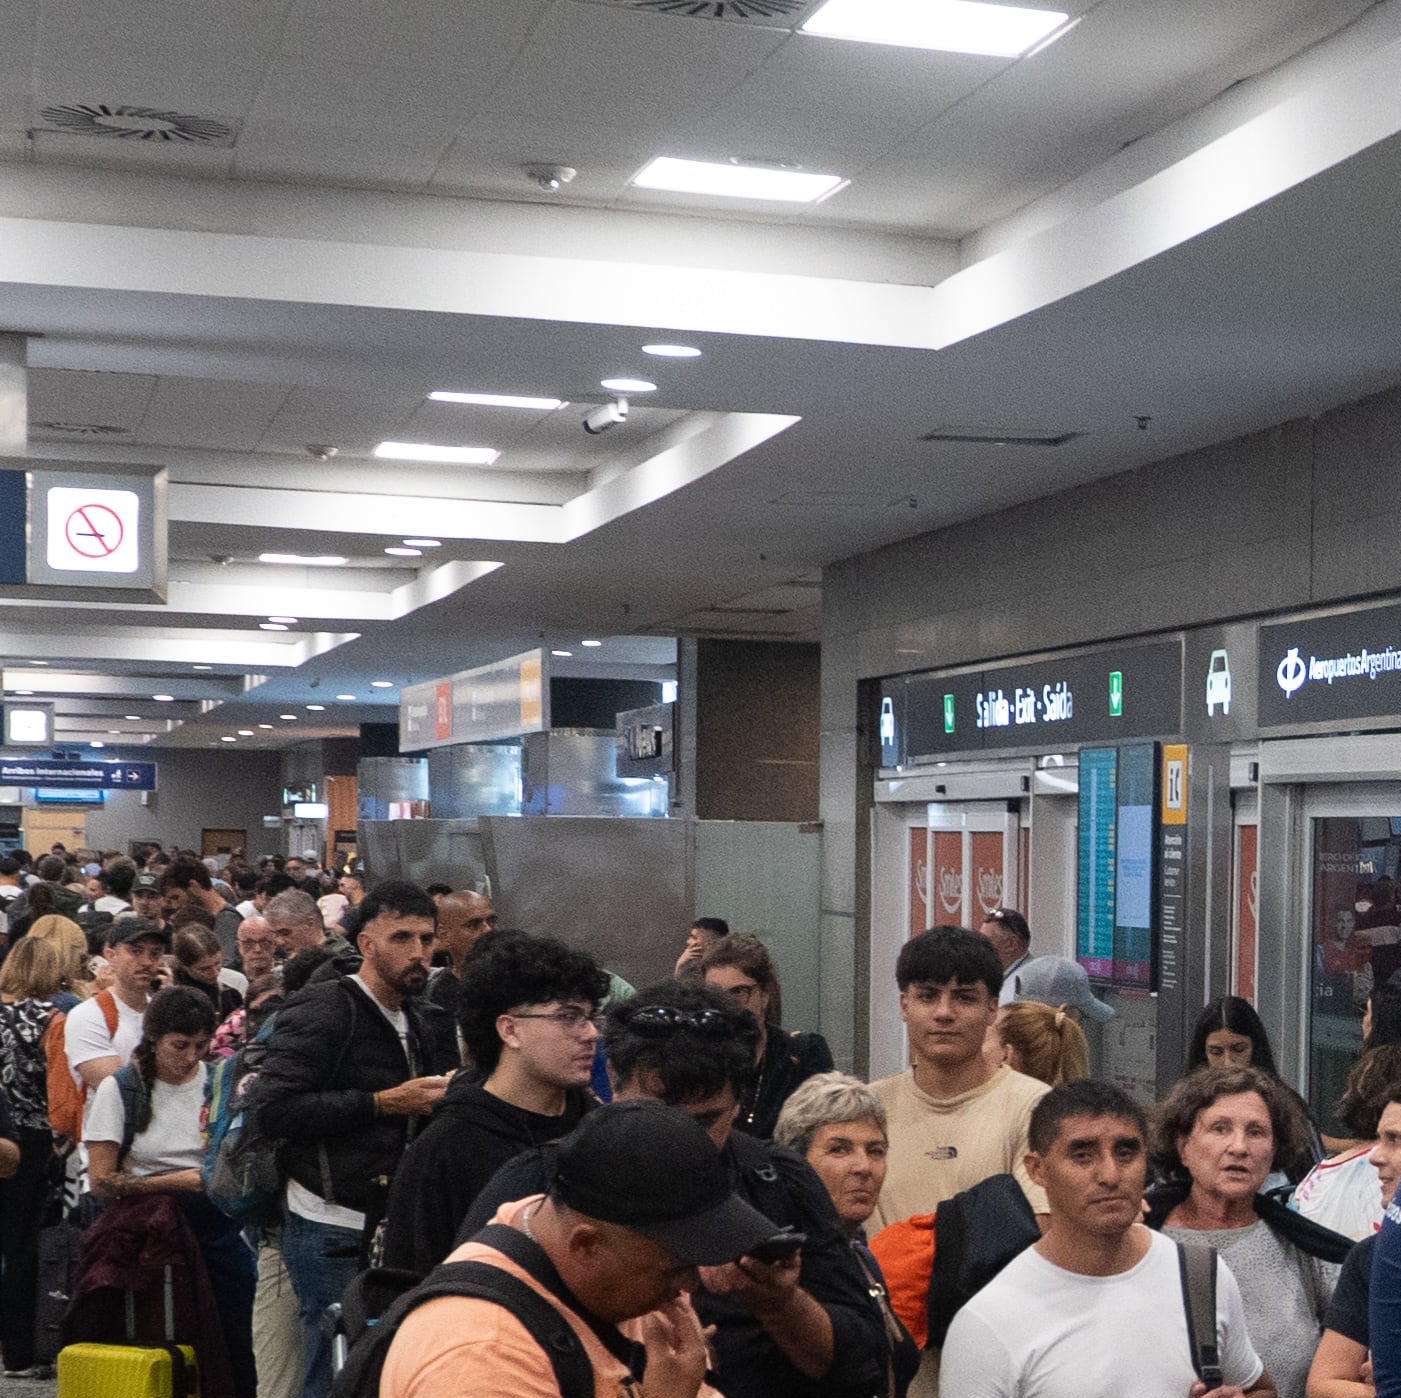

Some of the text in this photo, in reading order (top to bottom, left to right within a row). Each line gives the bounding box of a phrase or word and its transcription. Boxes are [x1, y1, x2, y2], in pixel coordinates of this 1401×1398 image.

[976, 681, 1073, 728] Salida Exit Saída
